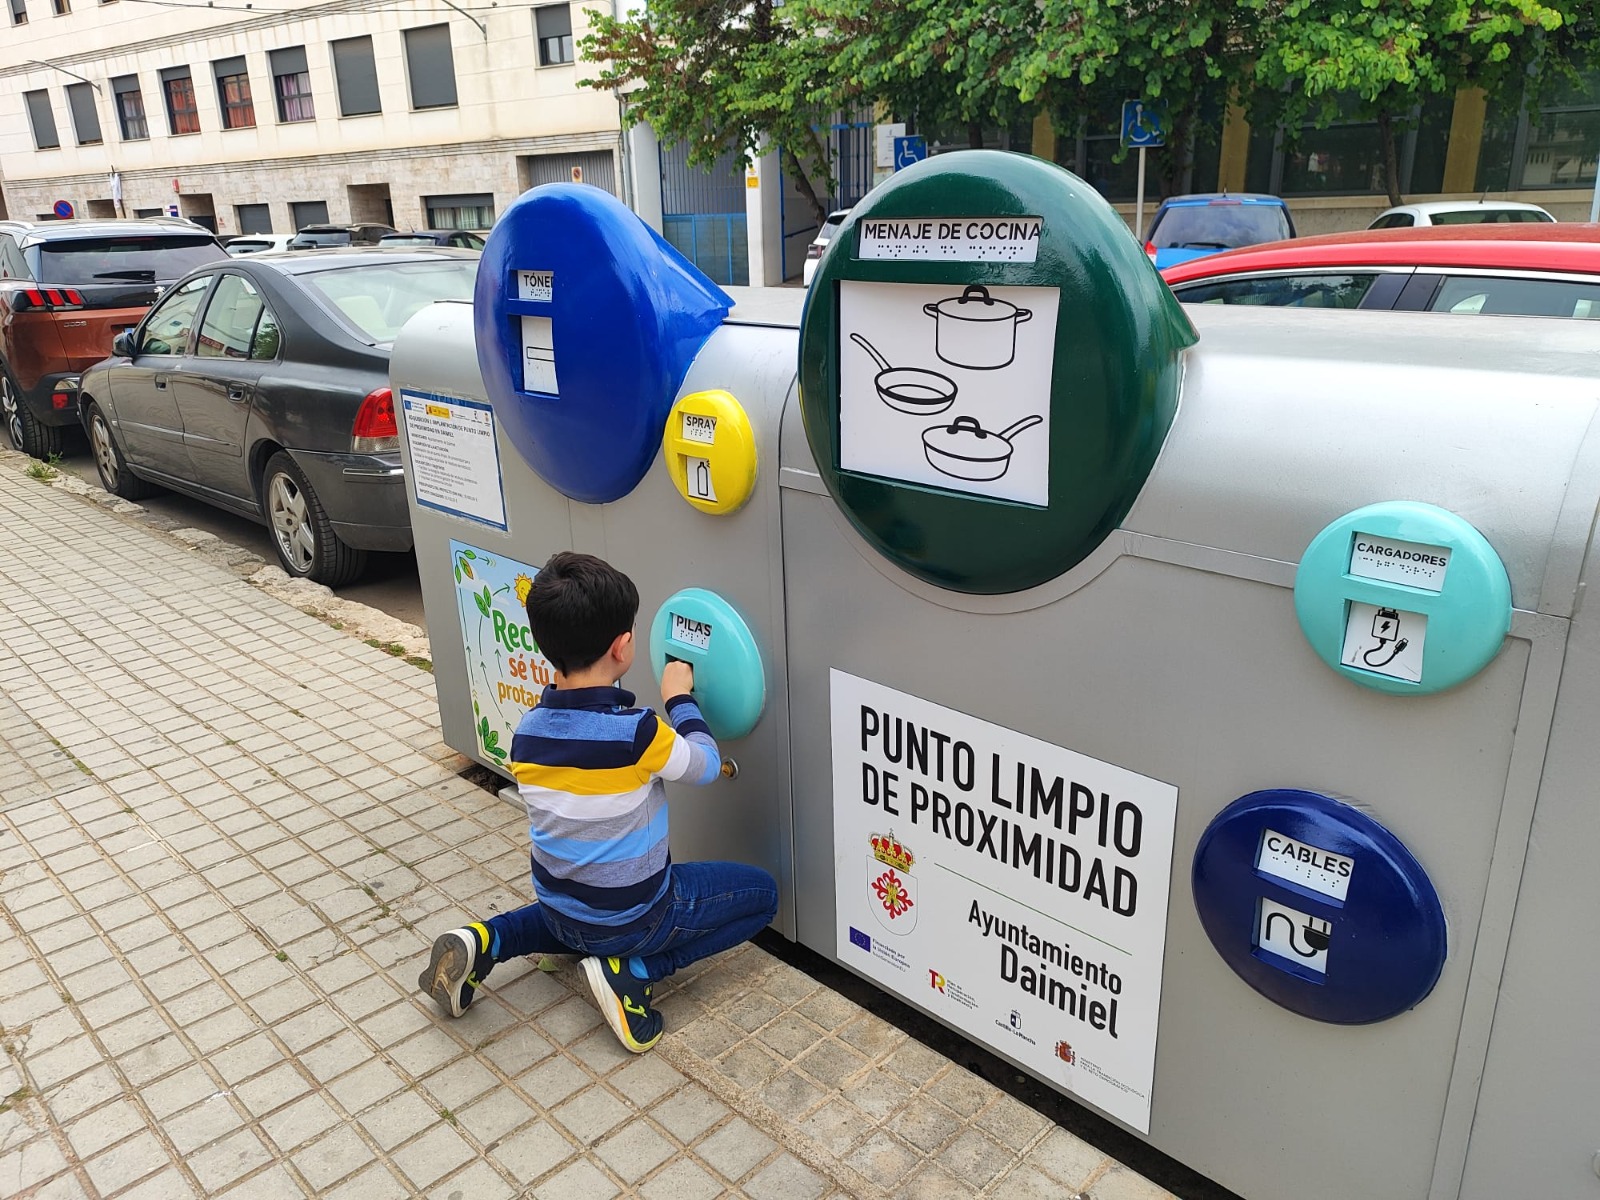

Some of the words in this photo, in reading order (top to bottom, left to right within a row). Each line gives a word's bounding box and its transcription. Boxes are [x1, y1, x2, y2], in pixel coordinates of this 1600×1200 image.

[865, 223, 933, 239] MENAJE
[938, 223, 962, 239] DE
[966, 223, 1041, 240] COCINA
[686, 416, 717, 430] SPRAY
[1357, 543, 1447, 567] CARGADORES
[676, 615, 711, 637] PILAS
[508, 653, 528, 680] sé
[530, 658, 550, 686] tú
[861, 704, 975, 792] PUNTO
[991, 753, 1143, 858] LIMPIO
[862, 762, 899, 817] DE
[910, 782, 1138, 918] PROXIMIDAD
[1267, 837, 1351, 877] CABLES
[968, 899, 1122, 995] Ayuntamiento
[1000, 943, 1118, 1040] Daimiel
